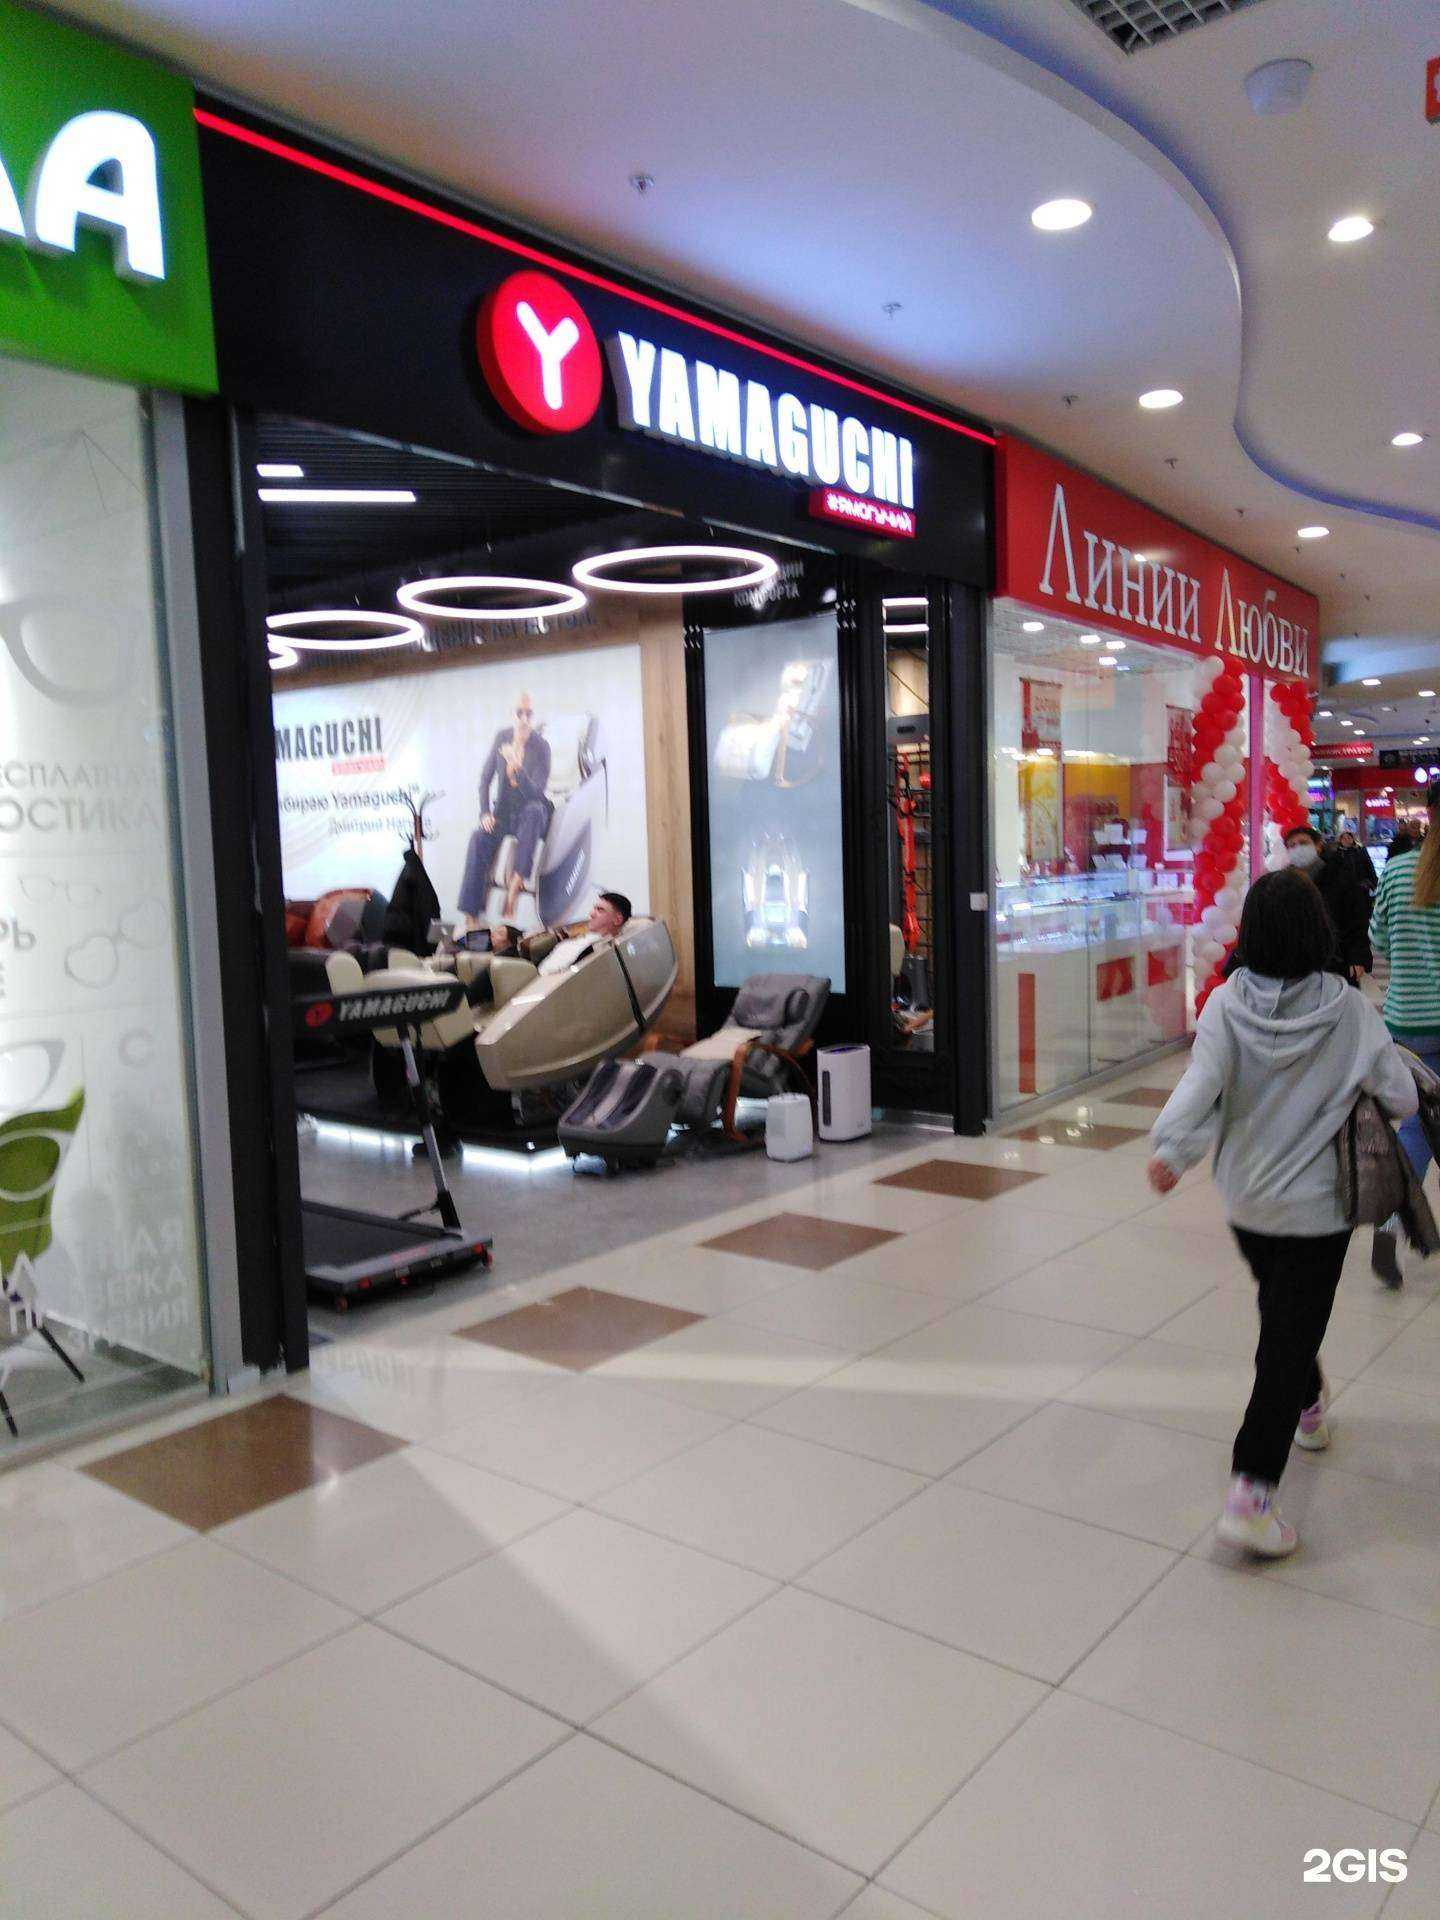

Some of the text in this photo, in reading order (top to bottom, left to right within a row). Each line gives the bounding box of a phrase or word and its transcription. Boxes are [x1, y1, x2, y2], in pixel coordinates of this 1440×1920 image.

[515, 300, 581, 411] Y
[616, 330, 916, 510] YAMAGUCHI
[339, 990, 451, 1022] YAMAGUCHI
